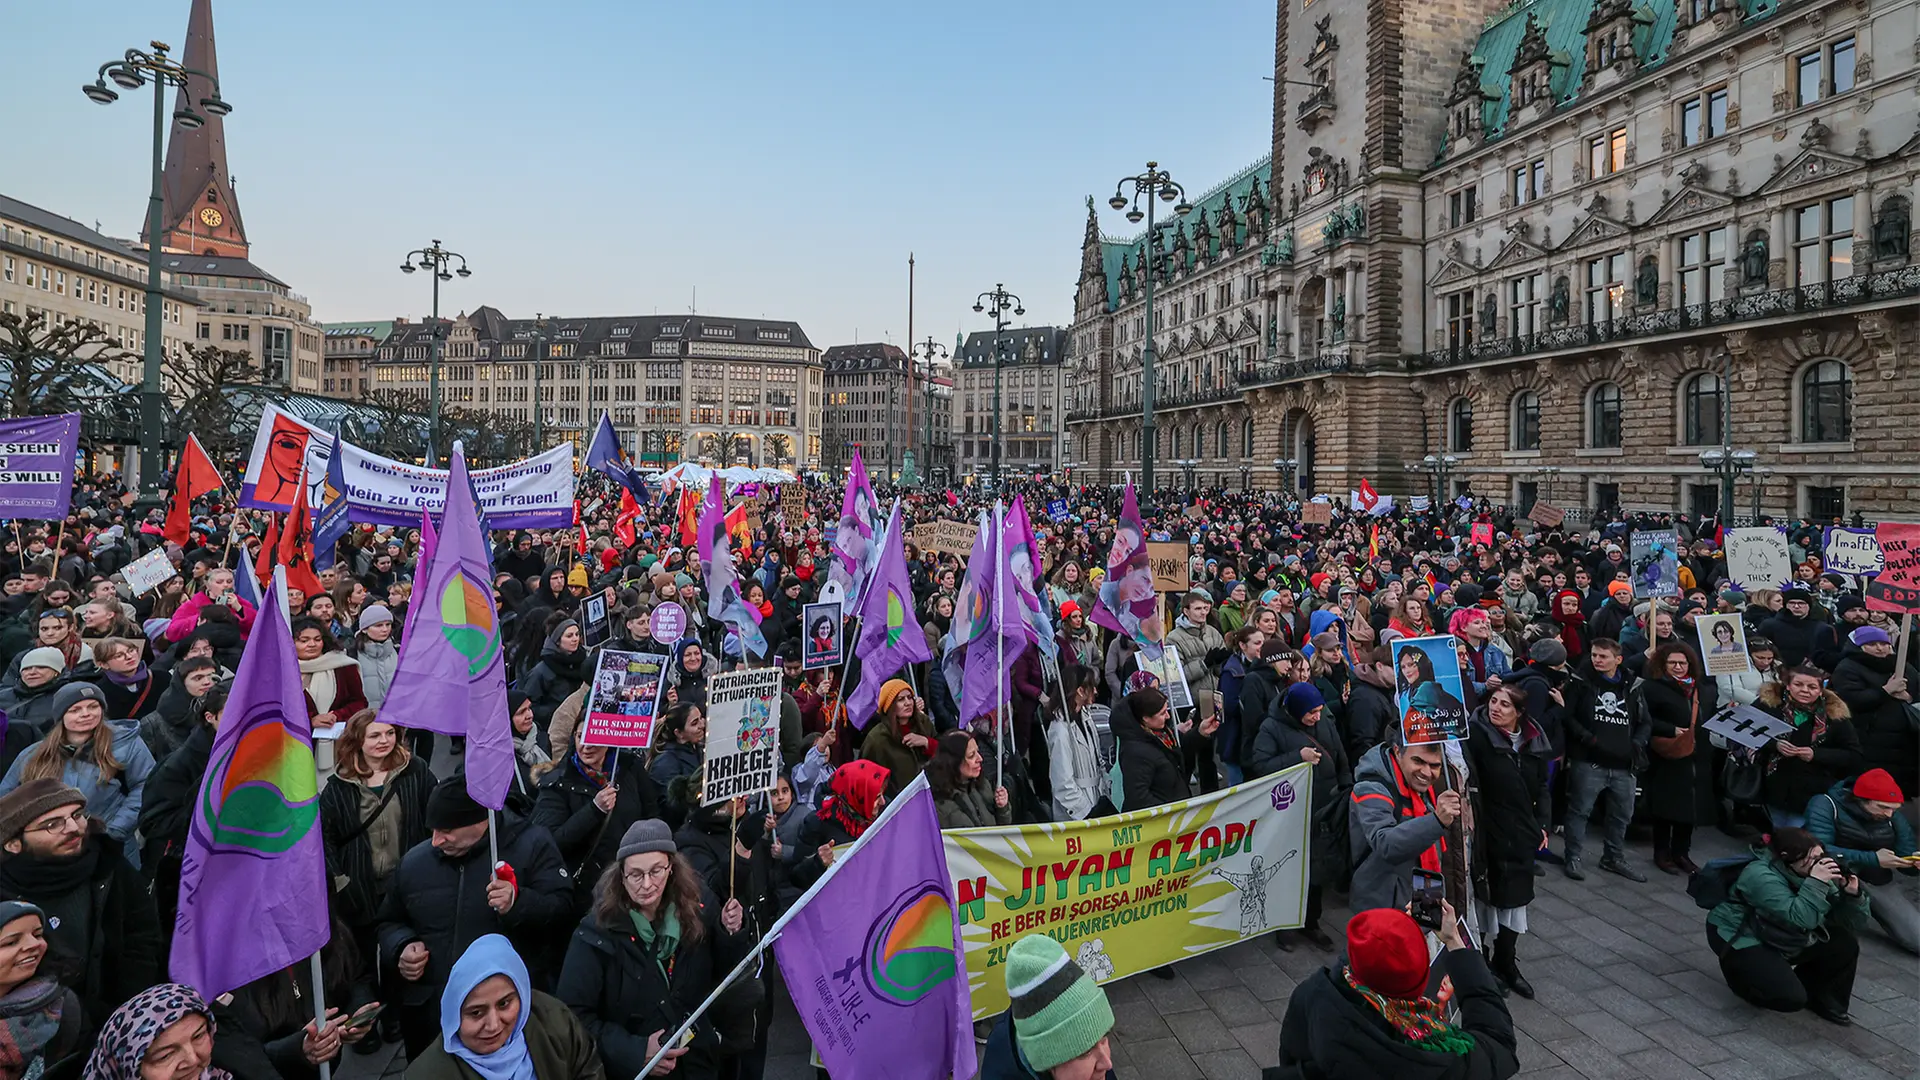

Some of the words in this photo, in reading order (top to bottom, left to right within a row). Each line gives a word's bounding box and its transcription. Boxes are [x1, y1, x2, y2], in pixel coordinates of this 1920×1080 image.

[6, 443, 59, 453] STEHT
[15, 472, 61, 482] WILL!
[345, 484, 382, 502] Nein
[388, 495, 409, 506] zu
[501, 491, 558, 506] Frauen!
[410, 484, 440, 494] von
[781, 505, 802, 513] DEM
[1882, 540, 1908, 553] KEEP
[1826, 552, 1856, 570] What's
[1857, 563, 1875, 573] your
[1891, 570, 1908, 582] OFF
[1883, 588, 1920, 601] BOD
[712, 671, 780, 691] PATRIARCHAT
[711, 684, 778, 705] ENTWAFFNEN!
[1452, 708, 1461, 717] زن
[591, 718, 609, 727] WIR
[610, 720, 632, 729] SIND
[633, 722, 649, 730] DIE
[589, 728, 647, 738] VERÄNDERUNG!
[707, 747, 774, 783] KRIEGE
[706, 769, 773, 802] BEENDEN
[1112, 824, 1143, 847] MIT
[1066, 836, 1082, 856] BI
[1003, 846, 1135, 911] JIYAN
[991, 917, 1012, 942] RE
[1015, 908, 1046, 932] BER
[1050, 902, 1066, 922] BI
[1068, 887, 1130, 921] ŞOREŞA
[1131, 877, 1164, 903] JINÊ
[1167, 875, 1190, 894] WE
